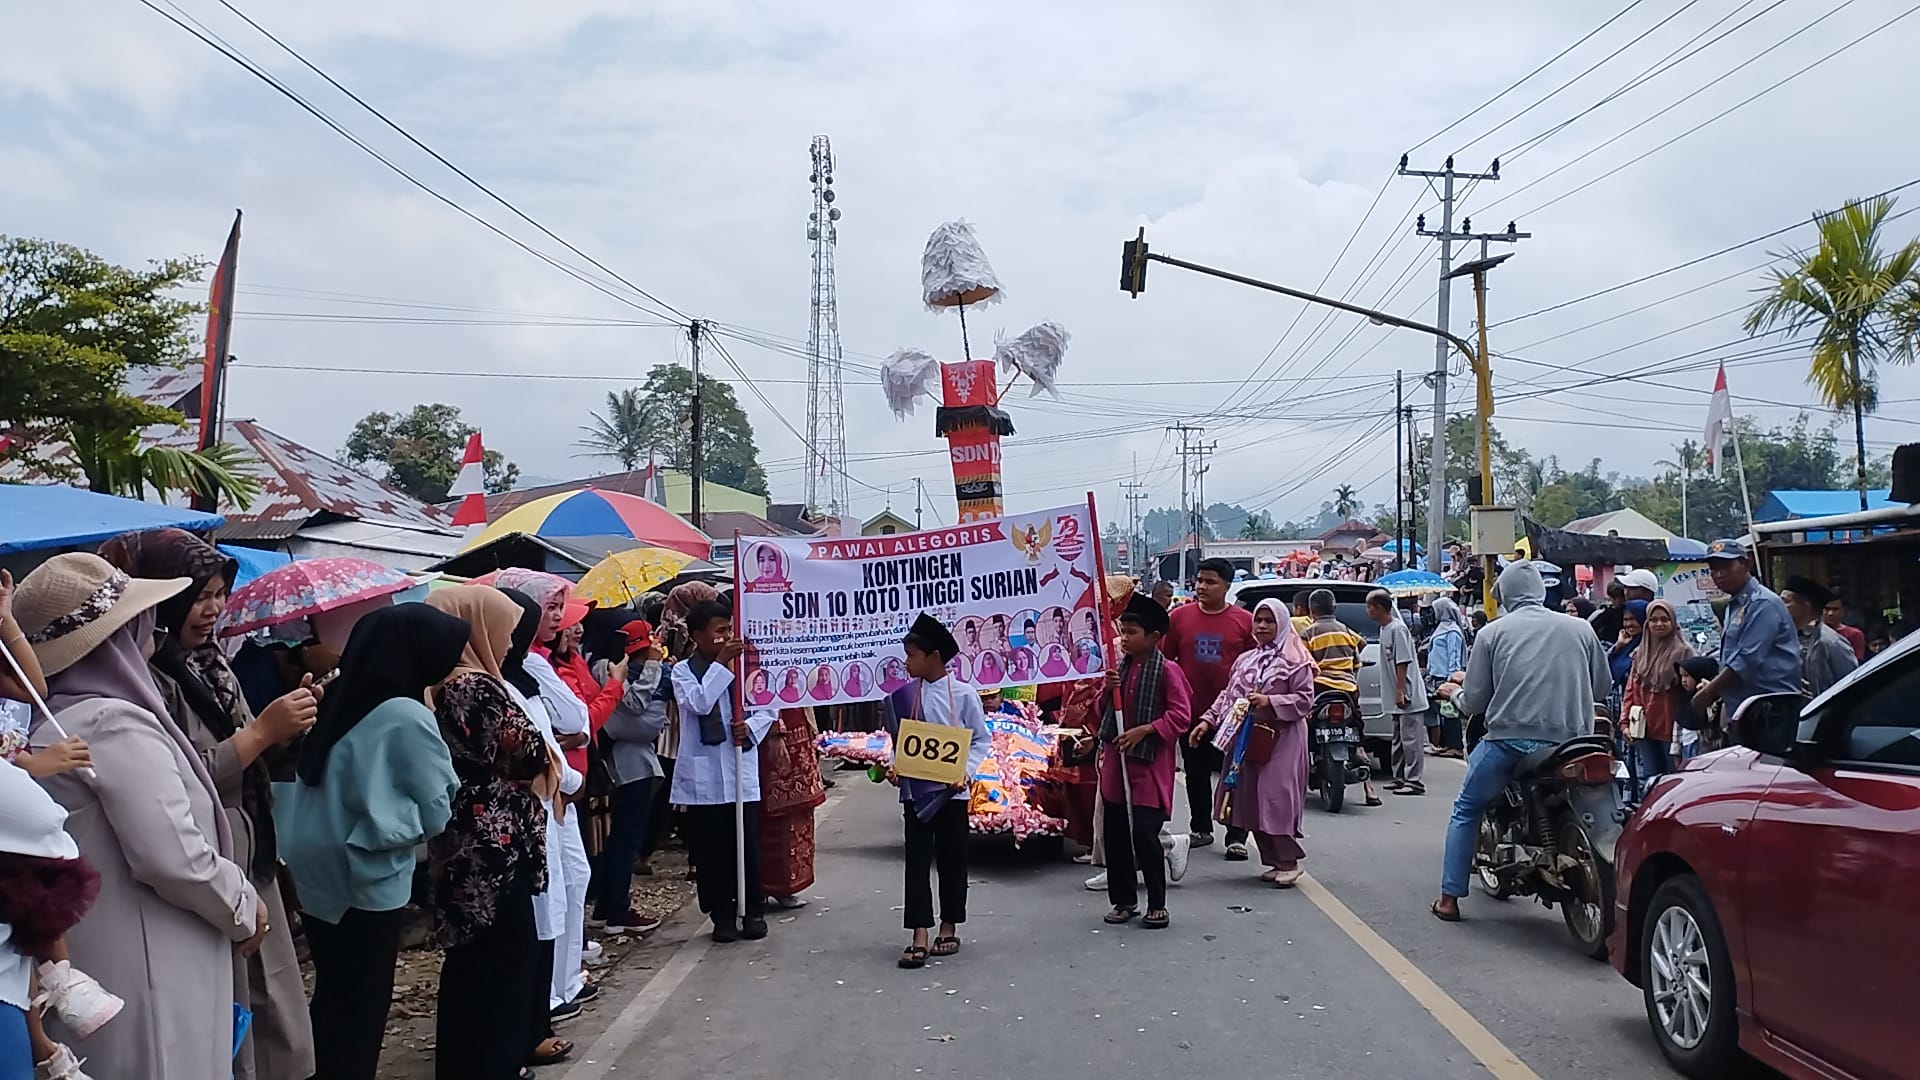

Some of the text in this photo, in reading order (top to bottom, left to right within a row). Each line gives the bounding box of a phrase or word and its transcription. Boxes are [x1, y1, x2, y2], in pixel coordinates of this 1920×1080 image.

[952, 443, 990, 463] SDN
[818, 528, 992, 559] PAWAI ALEGORIS
[862, 552, 963, 589] KONTINGEN
[782, 568, 1038, 619] SDN 10 KOTO TINGGI SURIAN
[903, 734, 960, 765] 082
